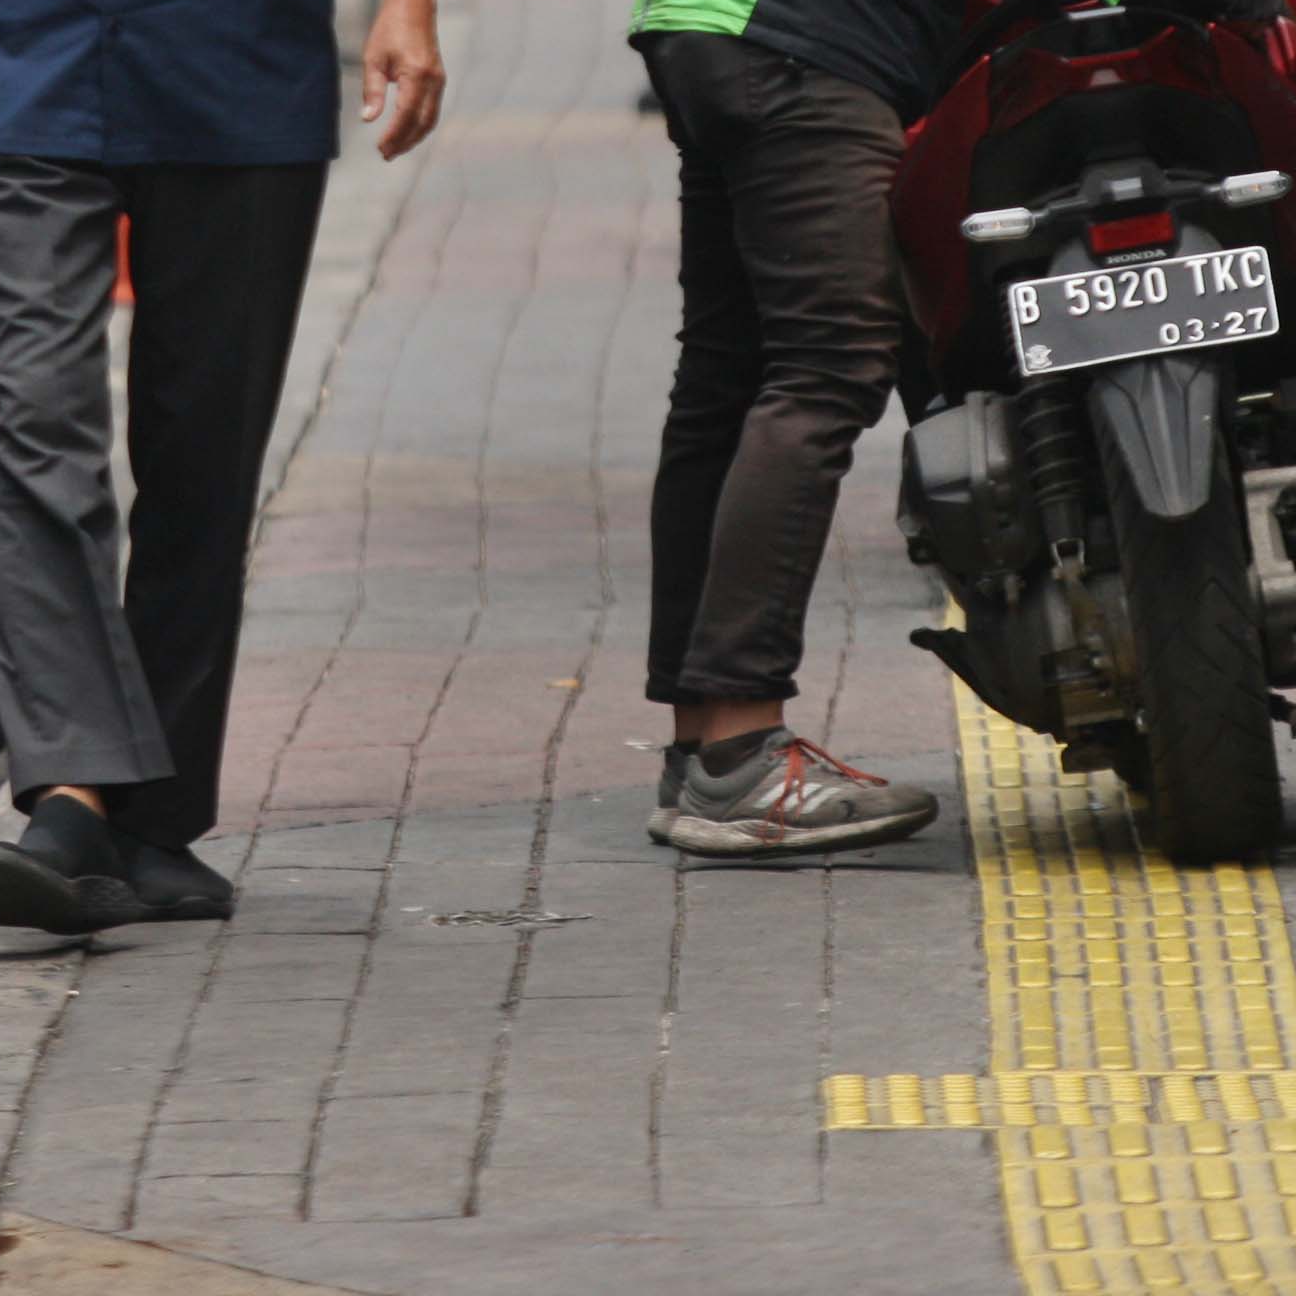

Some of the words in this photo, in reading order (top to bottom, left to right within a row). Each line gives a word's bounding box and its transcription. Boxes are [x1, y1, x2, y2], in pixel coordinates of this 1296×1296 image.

[1015, 285, 1041, 325] B
[1064, 266, 1168, 317] 5920
[1184, 251, 1267, 297] TKC
